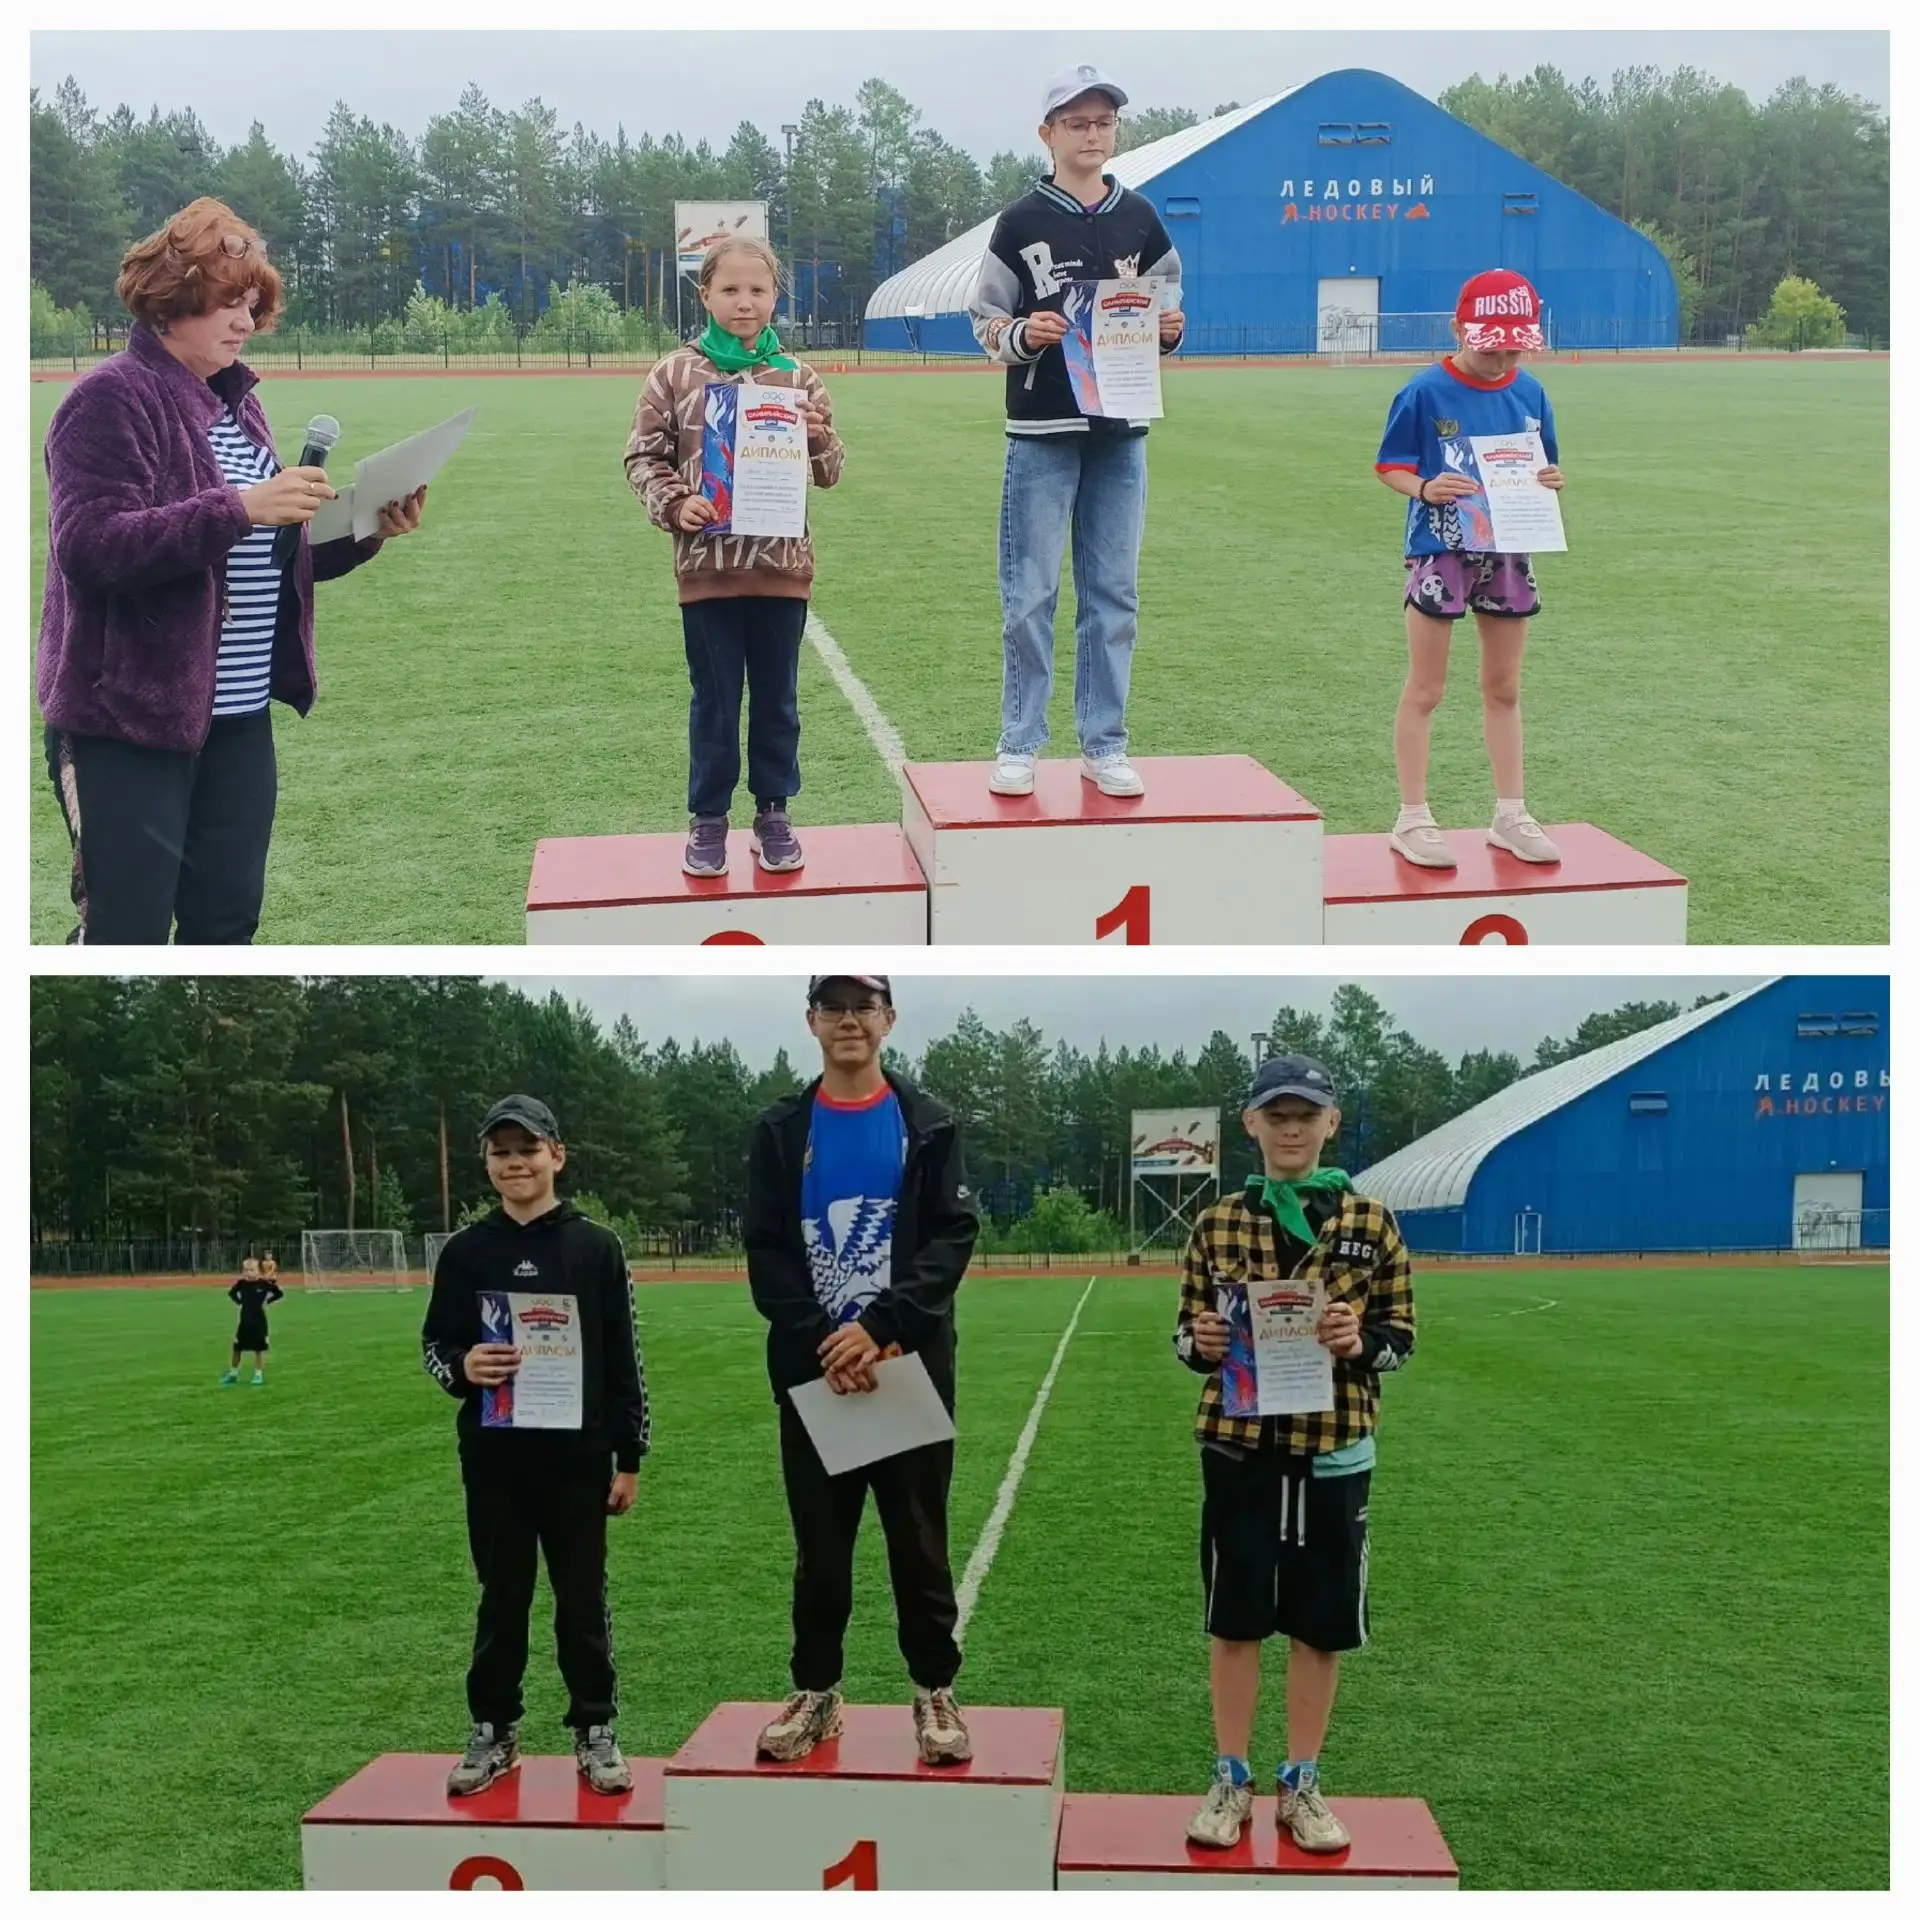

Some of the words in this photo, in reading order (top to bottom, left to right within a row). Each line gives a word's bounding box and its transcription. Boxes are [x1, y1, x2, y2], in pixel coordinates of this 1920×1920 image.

[1280, 174, 1434, 200] ЛЕДОВЫЙ
[1309, 203, 1399, 221] HOCKEY
[1474, 292, 1533, 318] RUSSIA
[1097, 331, 1153, 347] ДИПЛОМ
[740, 446, 802, 460] ДИПЛОМ
[1096, 885, 1151, 945] 1
